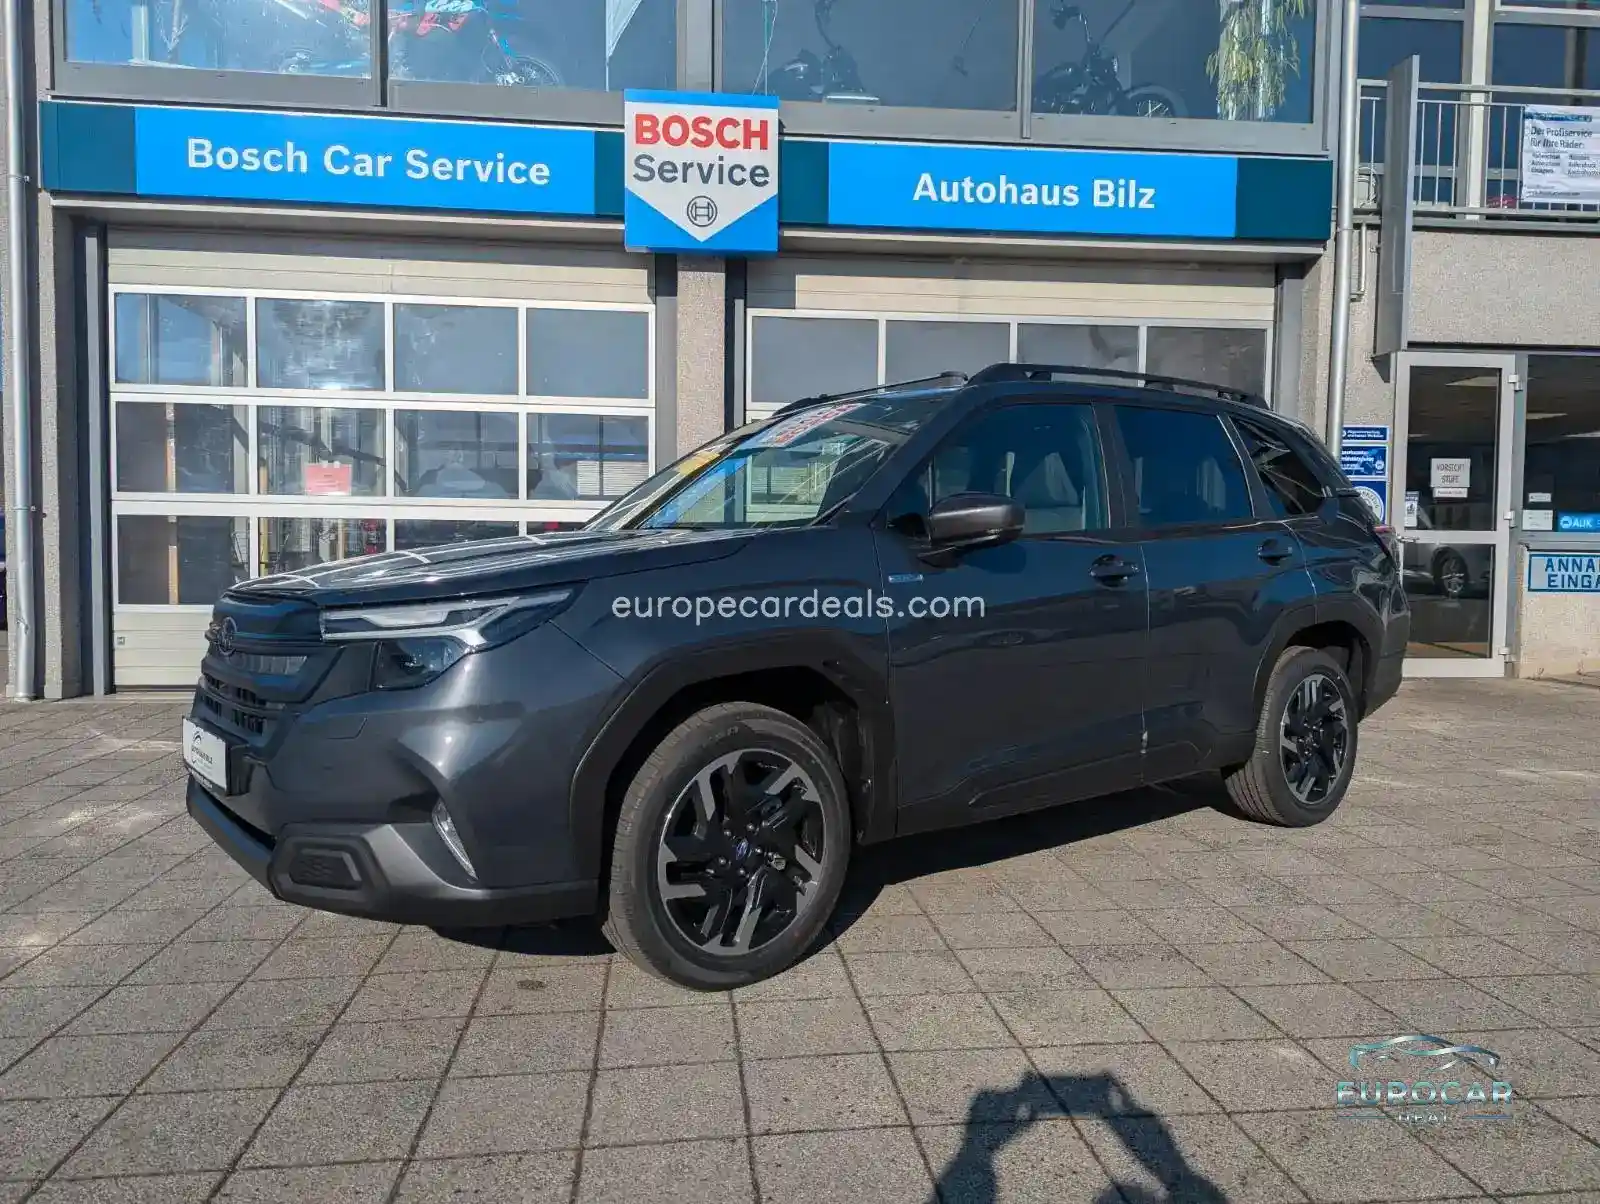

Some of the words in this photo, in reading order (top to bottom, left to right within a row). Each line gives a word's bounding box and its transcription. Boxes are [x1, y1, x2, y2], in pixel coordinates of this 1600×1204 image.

[635, 113, 768, 150] BOSCH
[187, 136, 308, 173] Bosch
[323, 144, 393, 178] Car
[405, 148, 551, 186] Service
[632, 153, 770, 188] Service
[912, 172, 1080, 206] Autohaus
[1092, 178, 1156, 209] Bilz
[1545, 558, 1600, 573] ANNA
